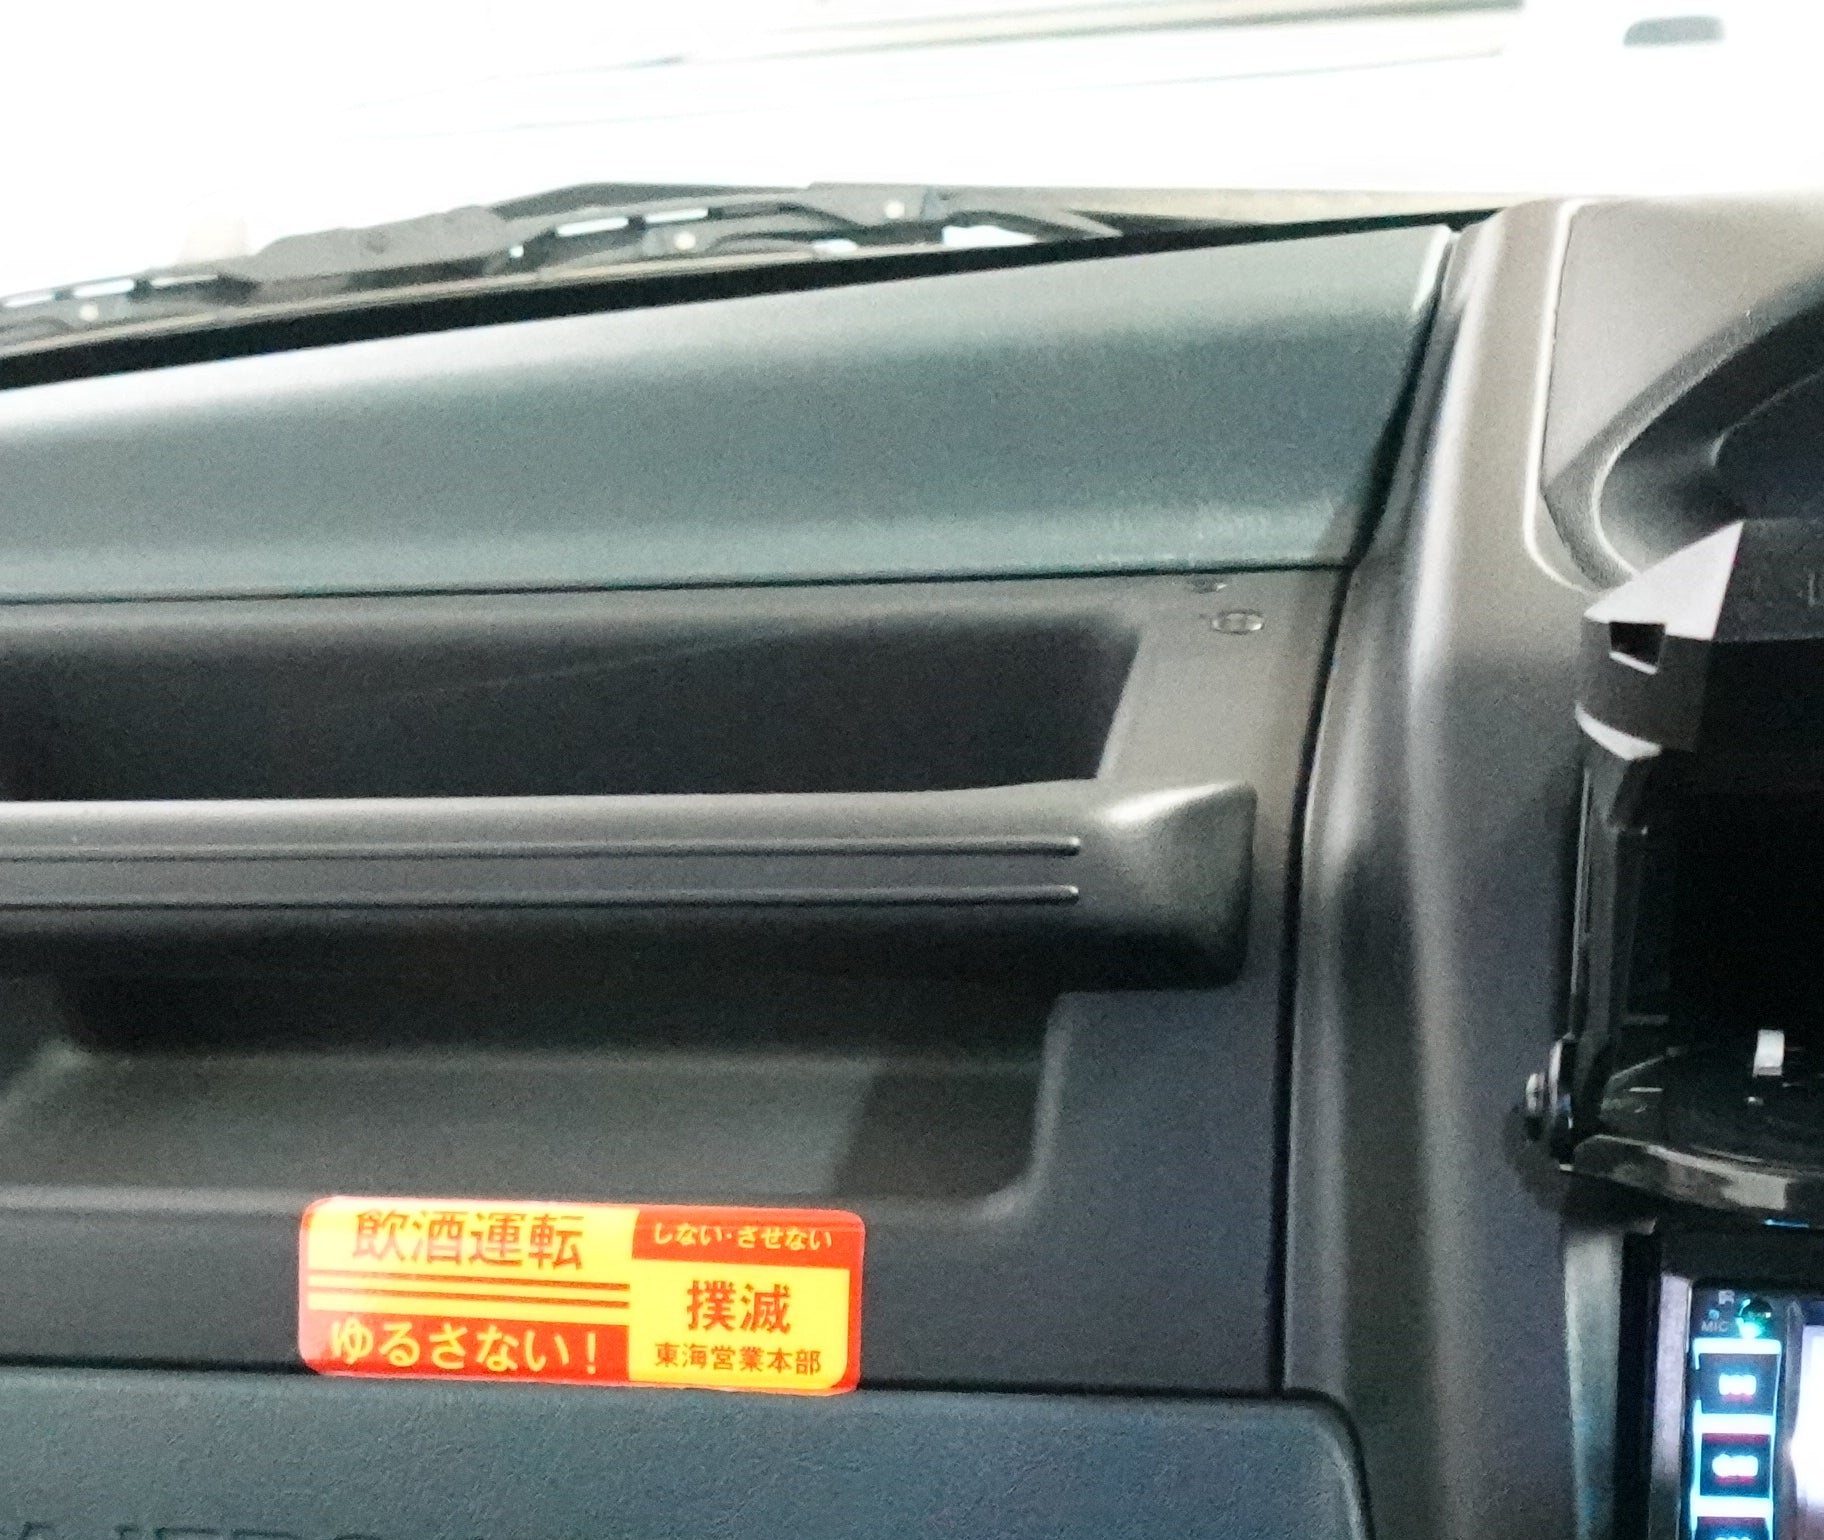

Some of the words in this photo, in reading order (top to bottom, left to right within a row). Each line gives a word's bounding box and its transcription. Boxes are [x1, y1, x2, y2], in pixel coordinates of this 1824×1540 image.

[353, 1208, 585, 1271] 飲酒運転
[687, 1280, 791, 1335] 撲滅
[655, 1342, 822, 1376] 東海営業本部
